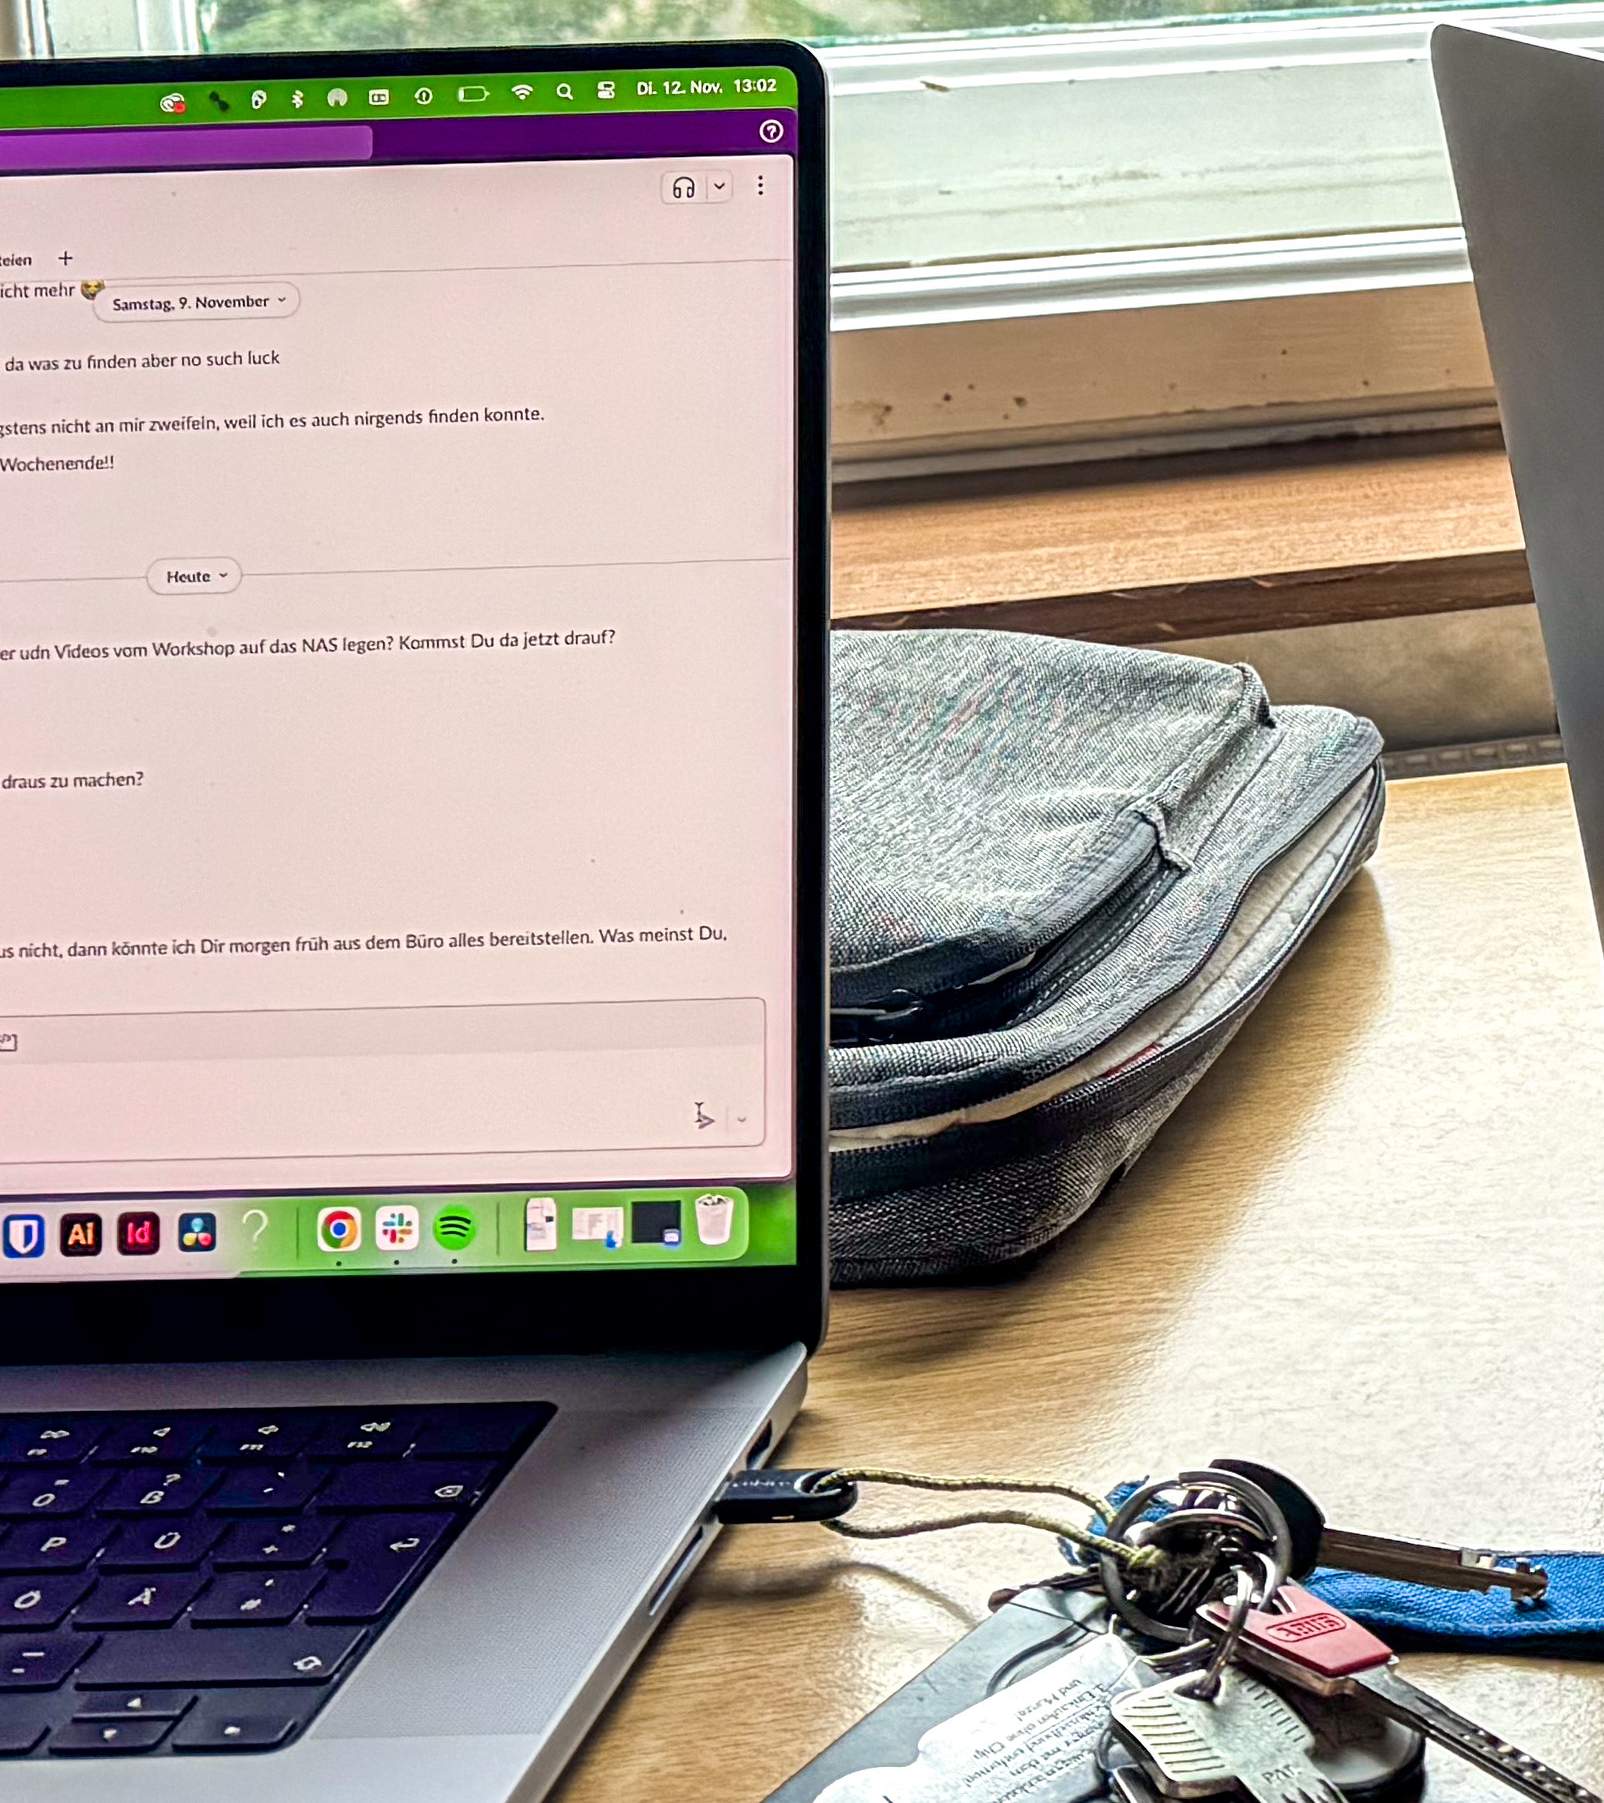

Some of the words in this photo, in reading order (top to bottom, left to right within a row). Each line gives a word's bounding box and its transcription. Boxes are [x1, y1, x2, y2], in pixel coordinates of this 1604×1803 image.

[637, 81, 657, 95] Di.
[663, 81, 686, 95] 12.
[690, 80, 723, 94] Nov.
[734, 78, 777, 93] 13:02
[34, 281, 75, 297] mehr
[112, 298, 175, 313] Samstag,
[179, 297, 192, 310] 9.
[195, 294, 270, 310] November
[5, 357, 24, 372] da
[29, 359, 59, 371] was
[63, 358, 82, 370] zu
[87, 354, 137, 370] finden
[141, 353, 178, 369] aber
[181, 356, 201, 367] no
[207, 351, 243, 367] such
[248, 349, 280, 366] luck
[51, 418, 91, 435] nicht
[95, 422, 115, 434] an
[119, 417, 144, 433] mir
[150, 415, 220, 433] zweifeln,
[224, 414, 256, 430] weil
[261, 413, 285, 428] ich
[290, 417, 307, 428] es
[312, 412, 350, 427] auch
[354, 409, 423, 429] nirgends
[429, 408, 479, 424] finden
[484, 407, 545, 423] konnte.
[0, 455, 115, 472] Wochenende!!
[167, 570, 211, 584] Heute
[20, 644, 50, 660] udn
[54, 643, 109, 659] Videos
[113, 646, 148, 658] vom
[152, 640, 235, 658] Workshop
[240, 639, 265, 655] auf
[269, 638, 298, 654] das
[302, 637, 338, 653] NAS
[342, 636, 394, 654] legen?
[399, 634, 466, 650] Kommst
[470, 633, 494, 648] Du
[499, 632, 520, 648] da
[522, 631, 560, 650] jetzt
[564, 629, 616, 646] drauf?
[2, 774, 46, 789] draus
[50, 776, 69, 788] zu
[73, 771, 144, 787] machen?
[19, 942, 63, 959] nicht,
[67, 941, 107, 957] dann
[112, 940, 168, 956] könnte
[172, 939, 196, 955] ich
[201, 938, 224, 954] Dir
[229, 939, 291, 957] morgen
[295, 936, 329, 952] früh
[333, 938, 361, 952] aus
[365, 935, 401, 950] dem
[406, 933, 444, 949] Büro
[448, 932, 485, 947] alles
[489, 929, 594, 947] bereitstellen.
[599, 928, 635, 944] Was
[639, 927, 694, 943] meinst
